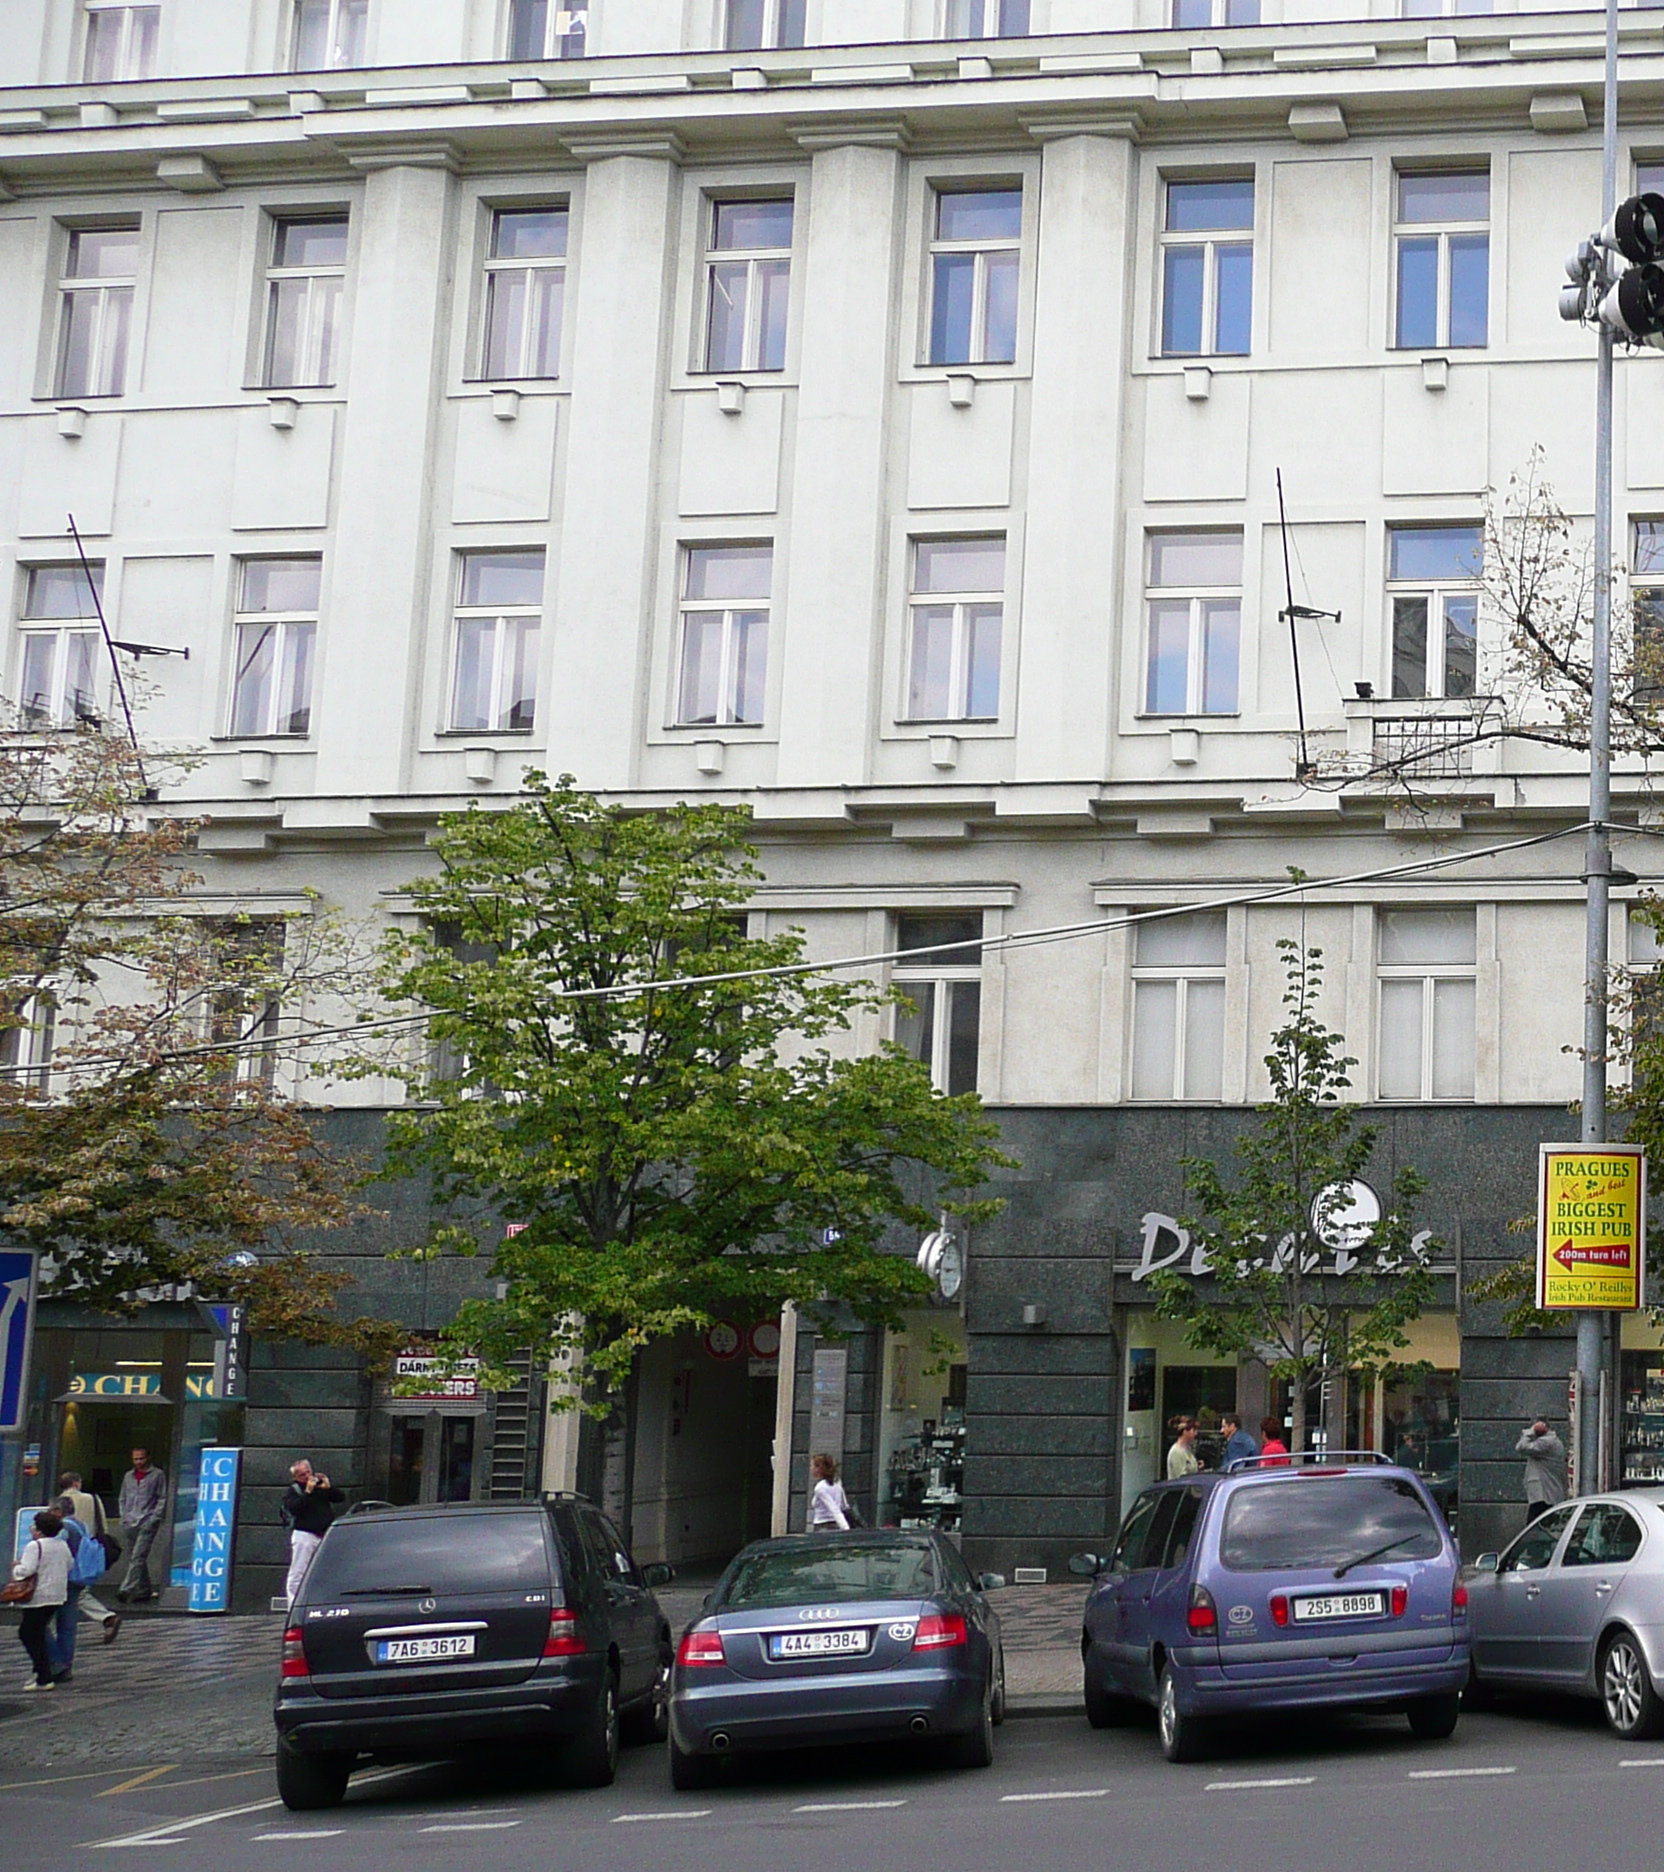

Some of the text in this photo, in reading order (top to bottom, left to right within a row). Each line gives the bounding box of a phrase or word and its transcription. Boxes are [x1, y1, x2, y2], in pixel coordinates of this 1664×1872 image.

[1555, 1162, 1630, 1177] PRAGUES
[1586, 1186, 1606, 1199] and
[1557, 1202, 1627, 1218] BIGGEST
[1551, 1221, 1632, 1237] IRISH PUB
[1559, 1249, 1627, 1260] 200m turn left
[1548, 1280, 1580, 1293] Rocky
[226, 1306, 241, 1396] CHANGE
[204, 1457, 232, 1602] CHANGE
[1307, 1596, 1376, 1615] 2S5 8898
[892, 1626, 910, 1638] CZ
[391, 1638, 467, 1658] 7A6 3612
[785, 1633, 859, 1651] 4A4 3384
